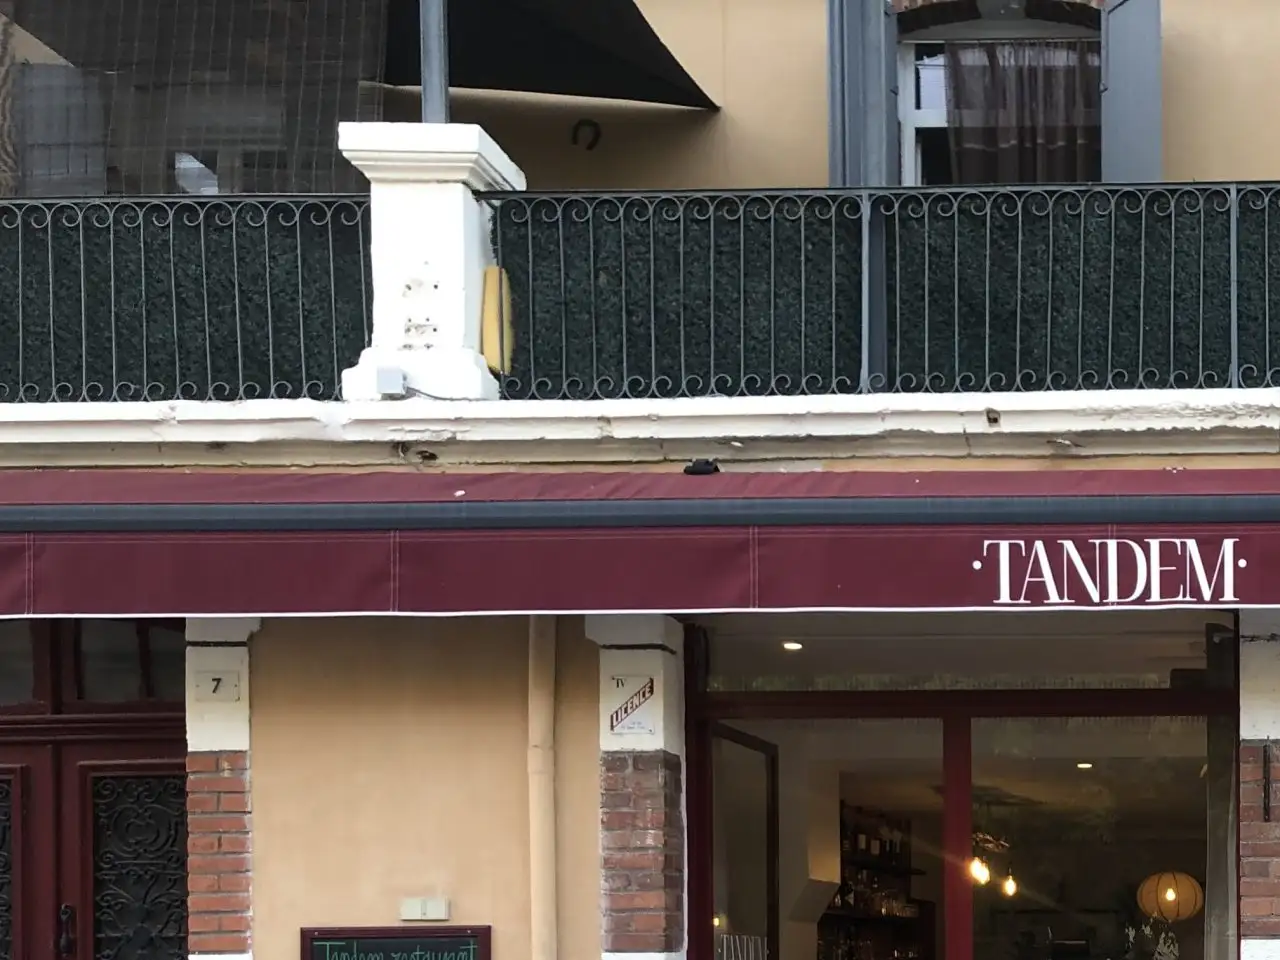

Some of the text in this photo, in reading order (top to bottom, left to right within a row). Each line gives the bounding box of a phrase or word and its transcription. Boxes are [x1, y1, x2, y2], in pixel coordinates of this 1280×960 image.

[983, 538, 1240, 603] TANDEM
[212, 677, 221, 693] 7
[612, 680, 653, 729] LICENCE
